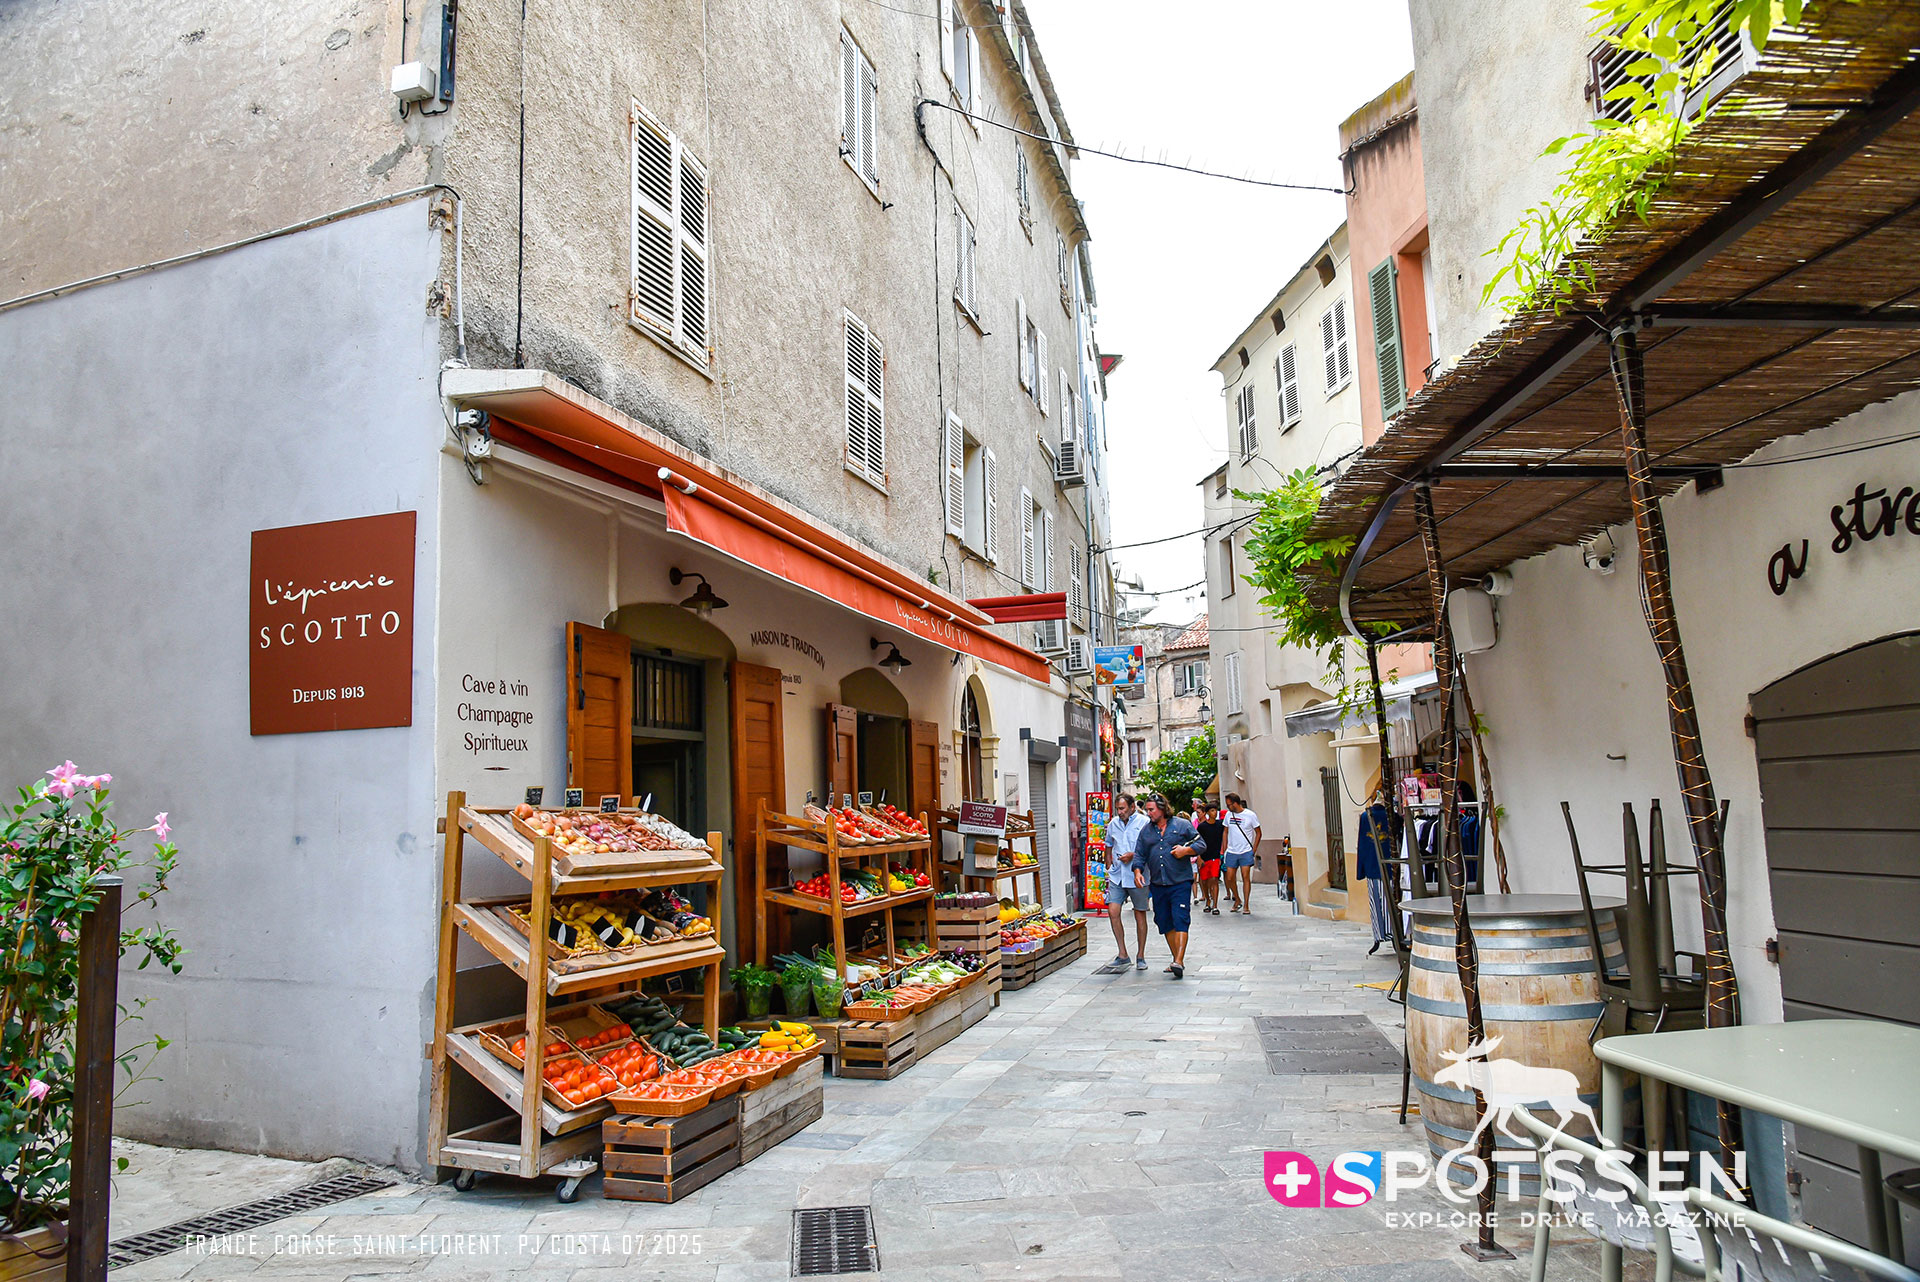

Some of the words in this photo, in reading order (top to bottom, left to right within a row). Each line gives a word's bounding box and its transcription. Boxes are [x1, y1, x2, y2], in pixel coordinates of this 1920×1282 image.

[1767, 538, 1809, 596] a
[259, 610, 401, 650] SCOTTO
[930, 617, 969, 647] SCOTTO
[750, 630, 780, 647] MAISON
[780, 632, 790, 648] DE
[790, 635, 826, 672] TRADITION
[340, 685, 366, 700] 1913
[462, 673, 496, 695] Cave
[499, 678, 508, 696] à
[510, 679, 529, 697] vin
[457, 703, 534, 728] Champagne
[463, 732, 530, 756] Spiritueux
[972, 811, 994, 819] SCOTTO
